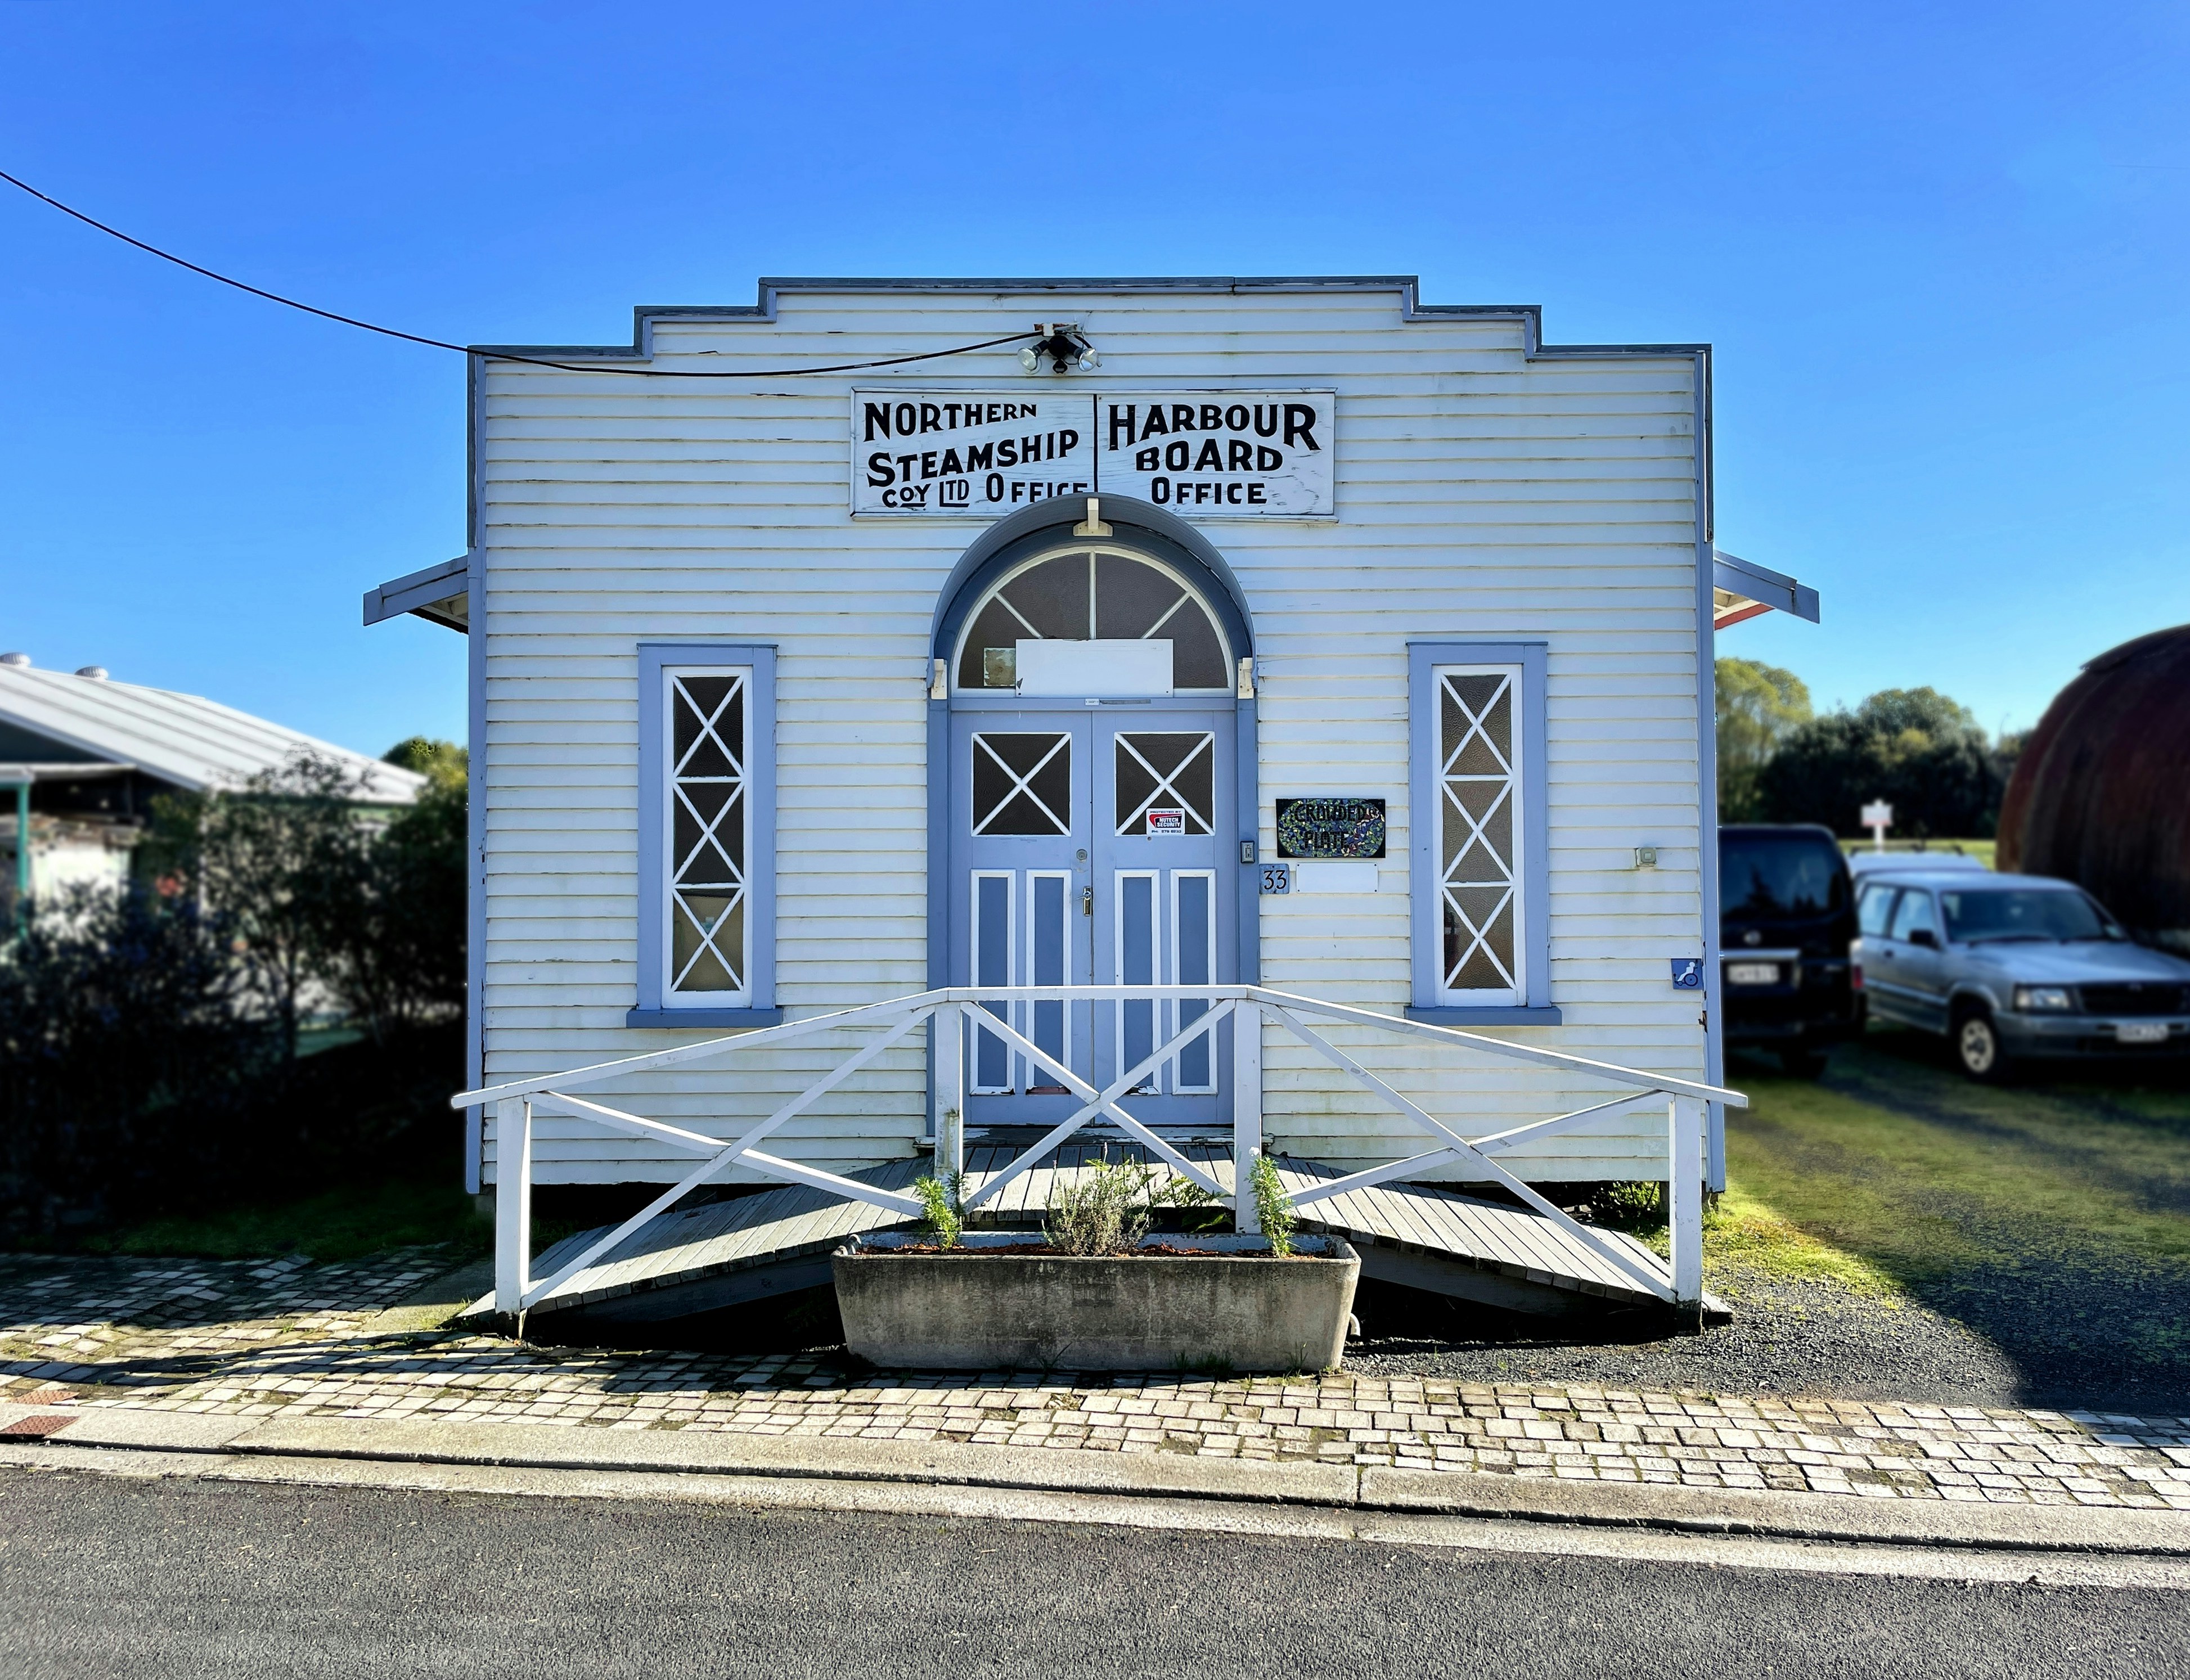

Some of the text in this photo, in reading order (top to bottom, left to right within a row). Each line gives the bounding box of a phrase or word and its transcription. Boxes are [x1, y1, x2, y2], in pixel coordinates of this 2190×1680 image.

[864, 402, 1037, 442] NORTHERN
[1107, 403, 1321, 452] HARBOUR
[867, 429, 1079, 488] STEAMSHIP
[1136, 438, 1283, 472] BOARD
[882, 483, 932, 508] COY
[939, 479, 969, 507] LTD
[1150, 476, 1267, 505] OFFICE
[1295, 804, 1366, 822] CROWDED
[1303, 831, 1350, 849] PLATE
[1263, 870, 1287, 890] 33
